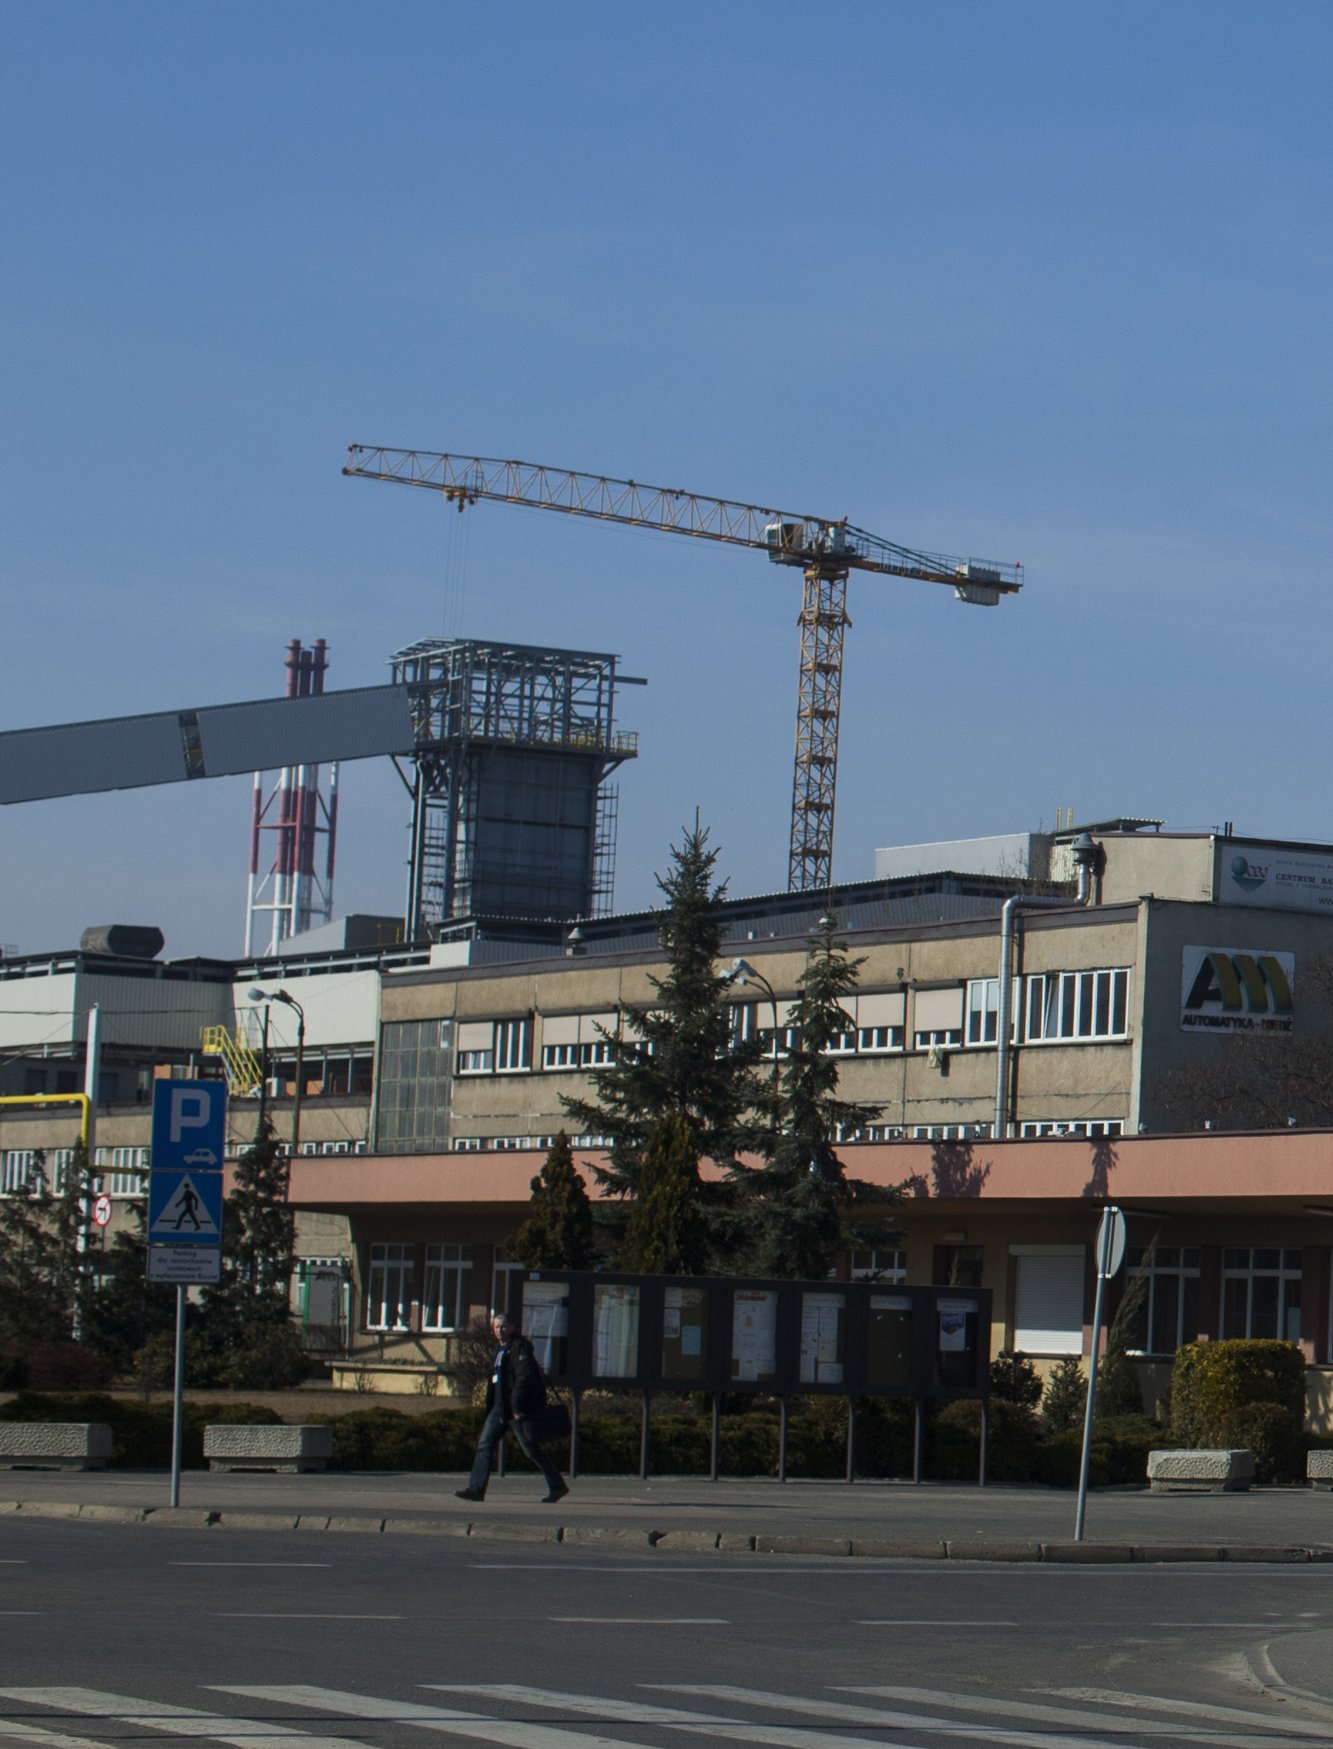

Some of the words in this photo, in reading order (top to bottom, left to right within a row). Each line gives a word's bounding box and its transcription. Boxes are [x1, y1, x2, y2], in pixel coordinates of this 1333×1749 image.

[1275, 873, 1316, 884] CENTRUM
[1182, 1014, 1254, 1029] AUTOMATYKA
[169, 1088, 212, 1142] P
